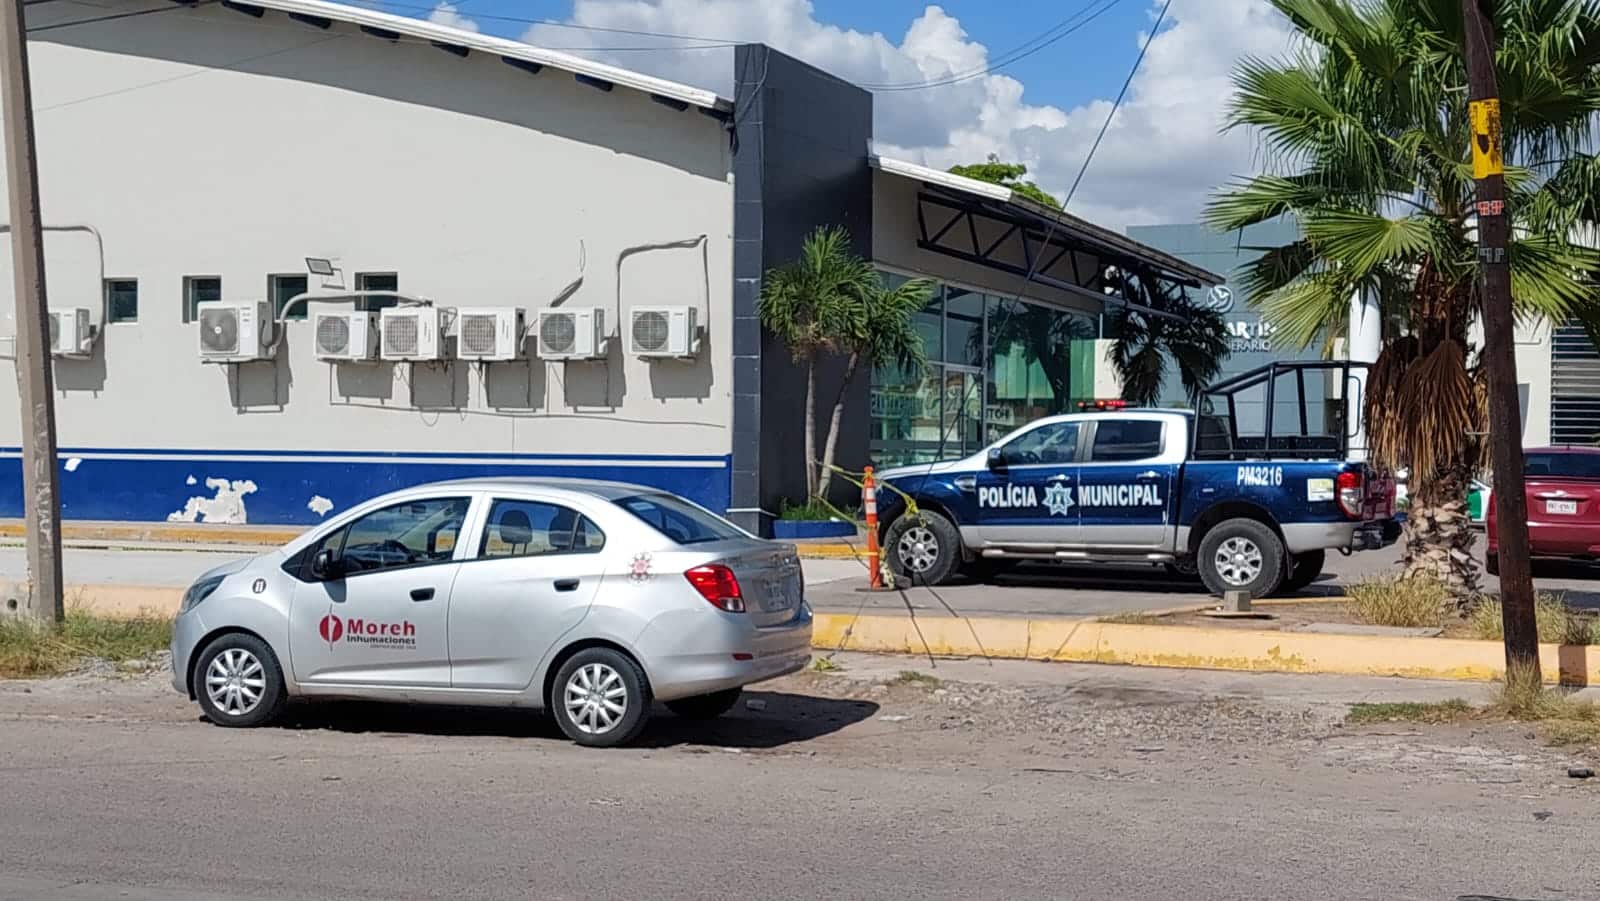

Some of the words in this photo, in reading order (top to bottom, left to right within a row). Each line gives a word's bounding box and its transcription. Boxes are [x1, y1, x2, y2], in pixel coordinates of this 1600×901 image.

[1236, 465, 1282, 487] PM3216
[978, 482, 1038, 508] POLÍCIA
[1077, 484, 1162, 508] MUNICIPAL
[347, 618, 415, 635] Moreh
[346, 635, 416, 645] Inhumaciones
